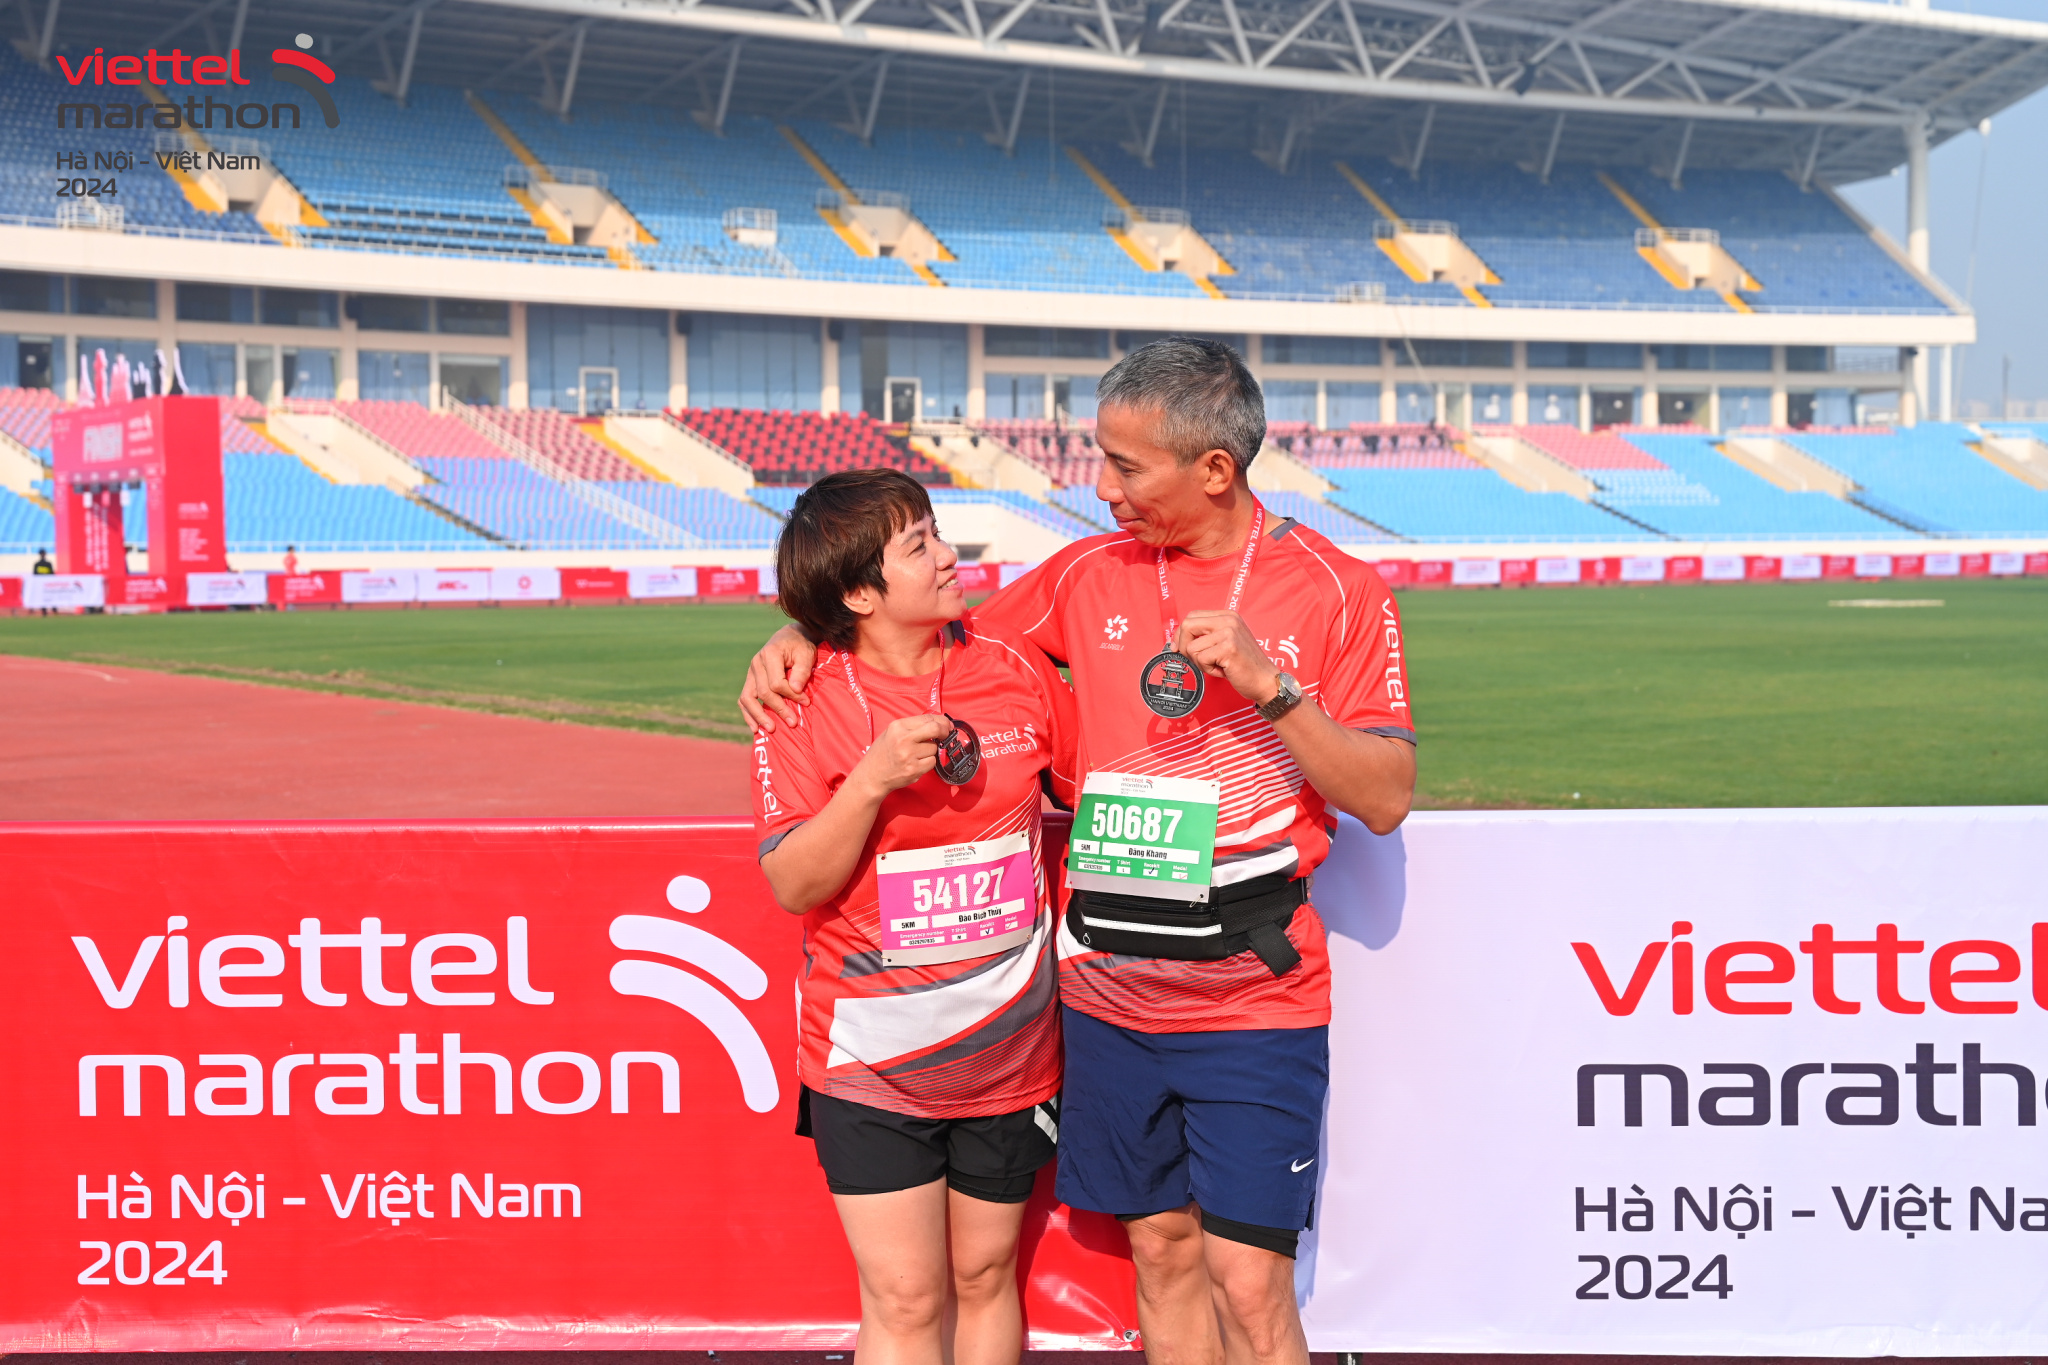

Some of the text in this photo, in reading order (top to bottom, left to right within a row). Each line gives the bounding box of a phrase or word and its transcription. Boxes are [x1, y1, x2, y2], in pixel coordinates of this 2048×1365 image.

[1158, 563, 1169, 600] VIETTEL
[1228, 508, 1263, 611] VIETTEL MARATHON 20
[1382, 598, 1408, 711] viettel
[844, 663, 869, 713] MARATHON
[981, 727, 1021, 745] ettel
[1091, 802, 1183, 843] 50687
[1146, 849, 1168, 859] Khang
[913, 866, 1004, 912] 54127
[901, 921, 916, 929] 5KM
[71, 915, 554, 1009] viettel
[78, 1032, 681, 1117] marathon
[1576, 1042, 2048, 1127] marath
[77, 1170, 152, 1219] Hà
[170, 1170, 265, 1227] Nội
[320, 1170, 435, 1226] Việt
[451, 1172, 582, 1219] Nam
[1575, 1183, 1654, 1232] Hà
[1674, 1183, 1773, 1239] Nội
[1831, 1183, 1952, 1239] Việt
[1969, 1186, 2048, 1232] Na
[77, 1240, 228, 1286] 2024
[1575, 1254, 1734, 1300] 2024
